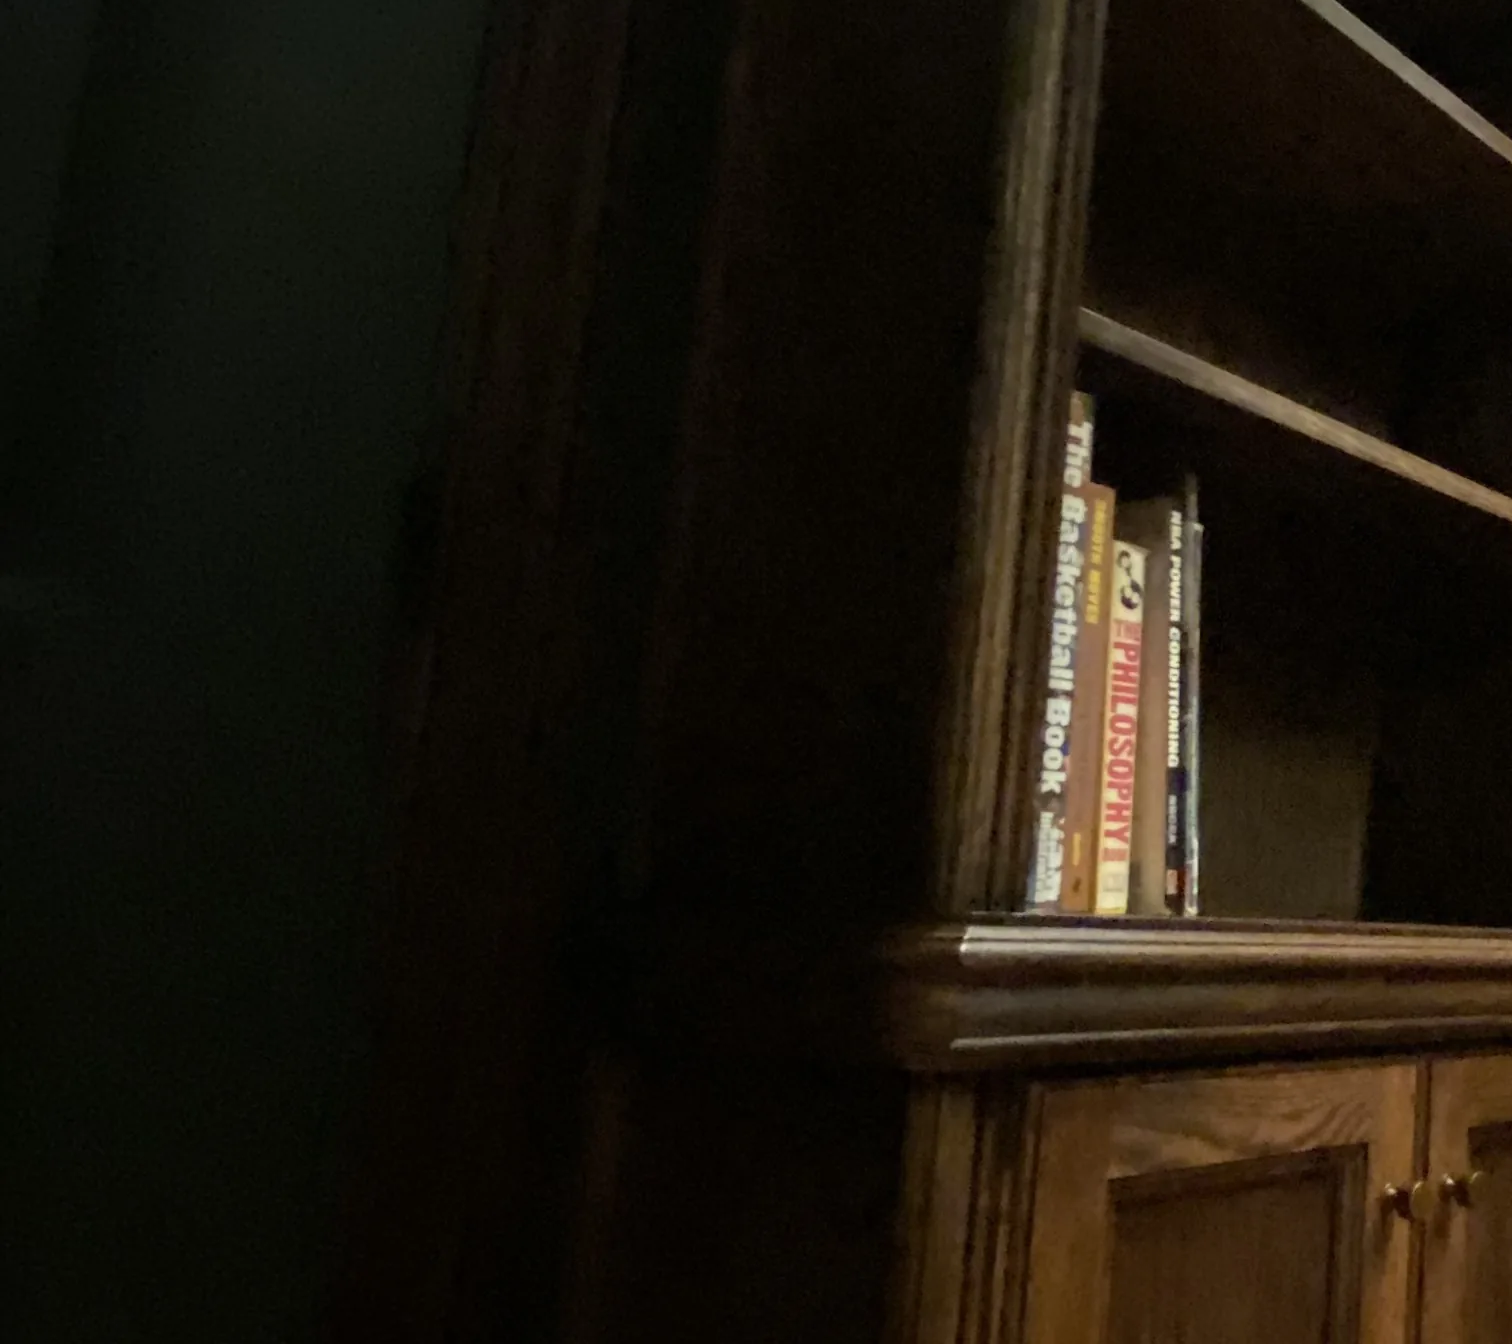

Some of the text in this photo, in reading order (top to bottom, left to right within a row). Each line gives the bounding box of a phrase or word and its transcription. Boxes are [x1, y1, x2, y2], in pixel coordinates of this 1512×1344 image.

[1061, 421, 1093, 489] The
[1047, 495, 1086, 691] Basketball
[1165, 511, 1183, 769] NBA POWER CONDITIONING
[1040, 697, 1074, 795] Book
[1102, 642, 1140, 847] PHILOSOPHY
